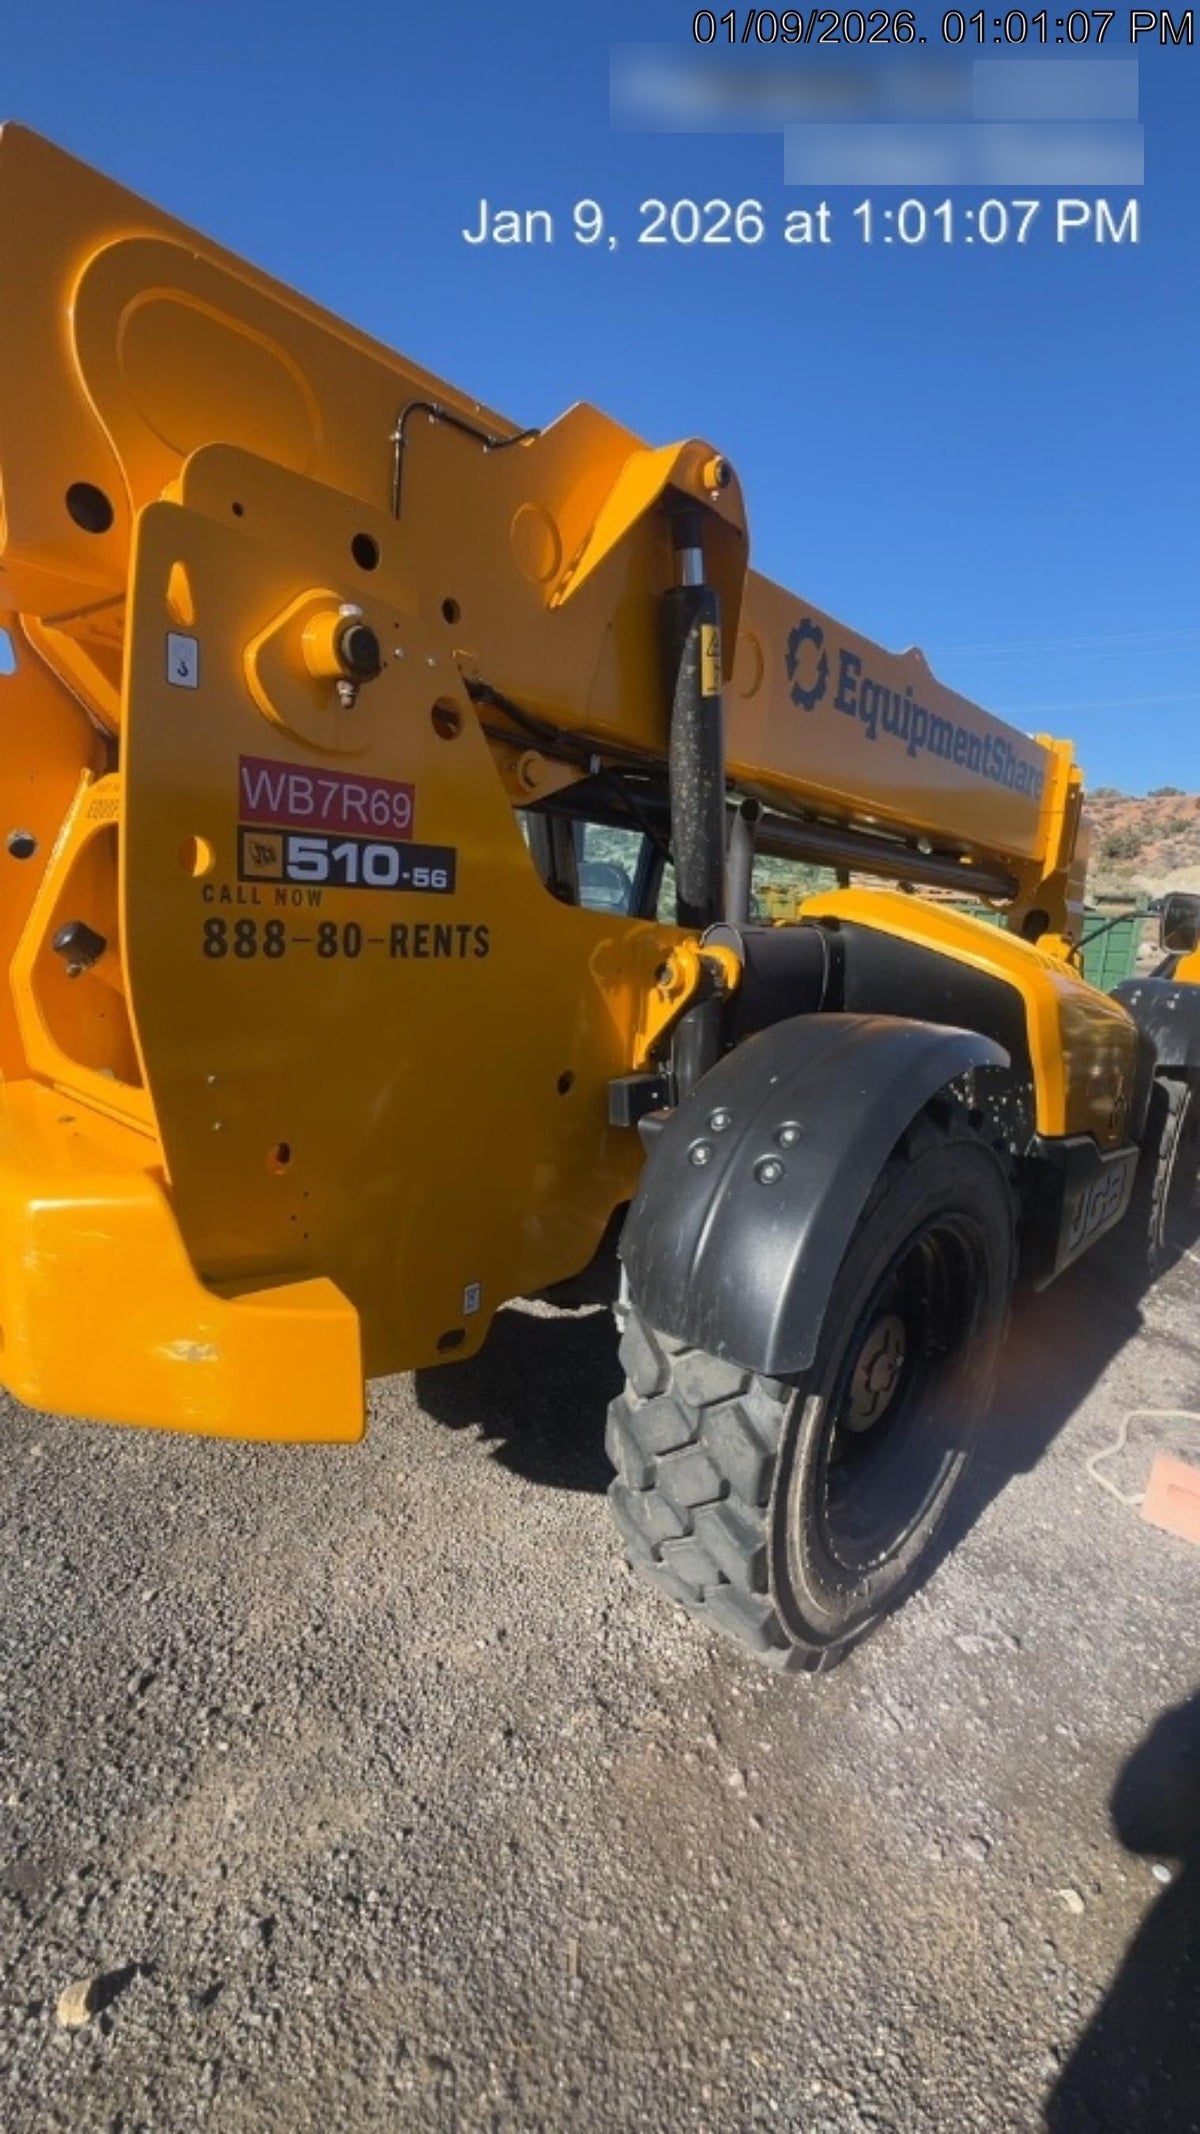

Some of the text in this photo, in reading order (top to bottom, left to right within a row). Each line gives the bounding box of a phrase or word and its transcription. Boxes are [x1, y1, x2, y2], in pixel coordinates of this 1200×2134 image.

[834, 647, 1045, 800] EquipmentShare
[242, 767, 411, 829] WB7R69
[202, 884, 323, 907] CALL NOW
